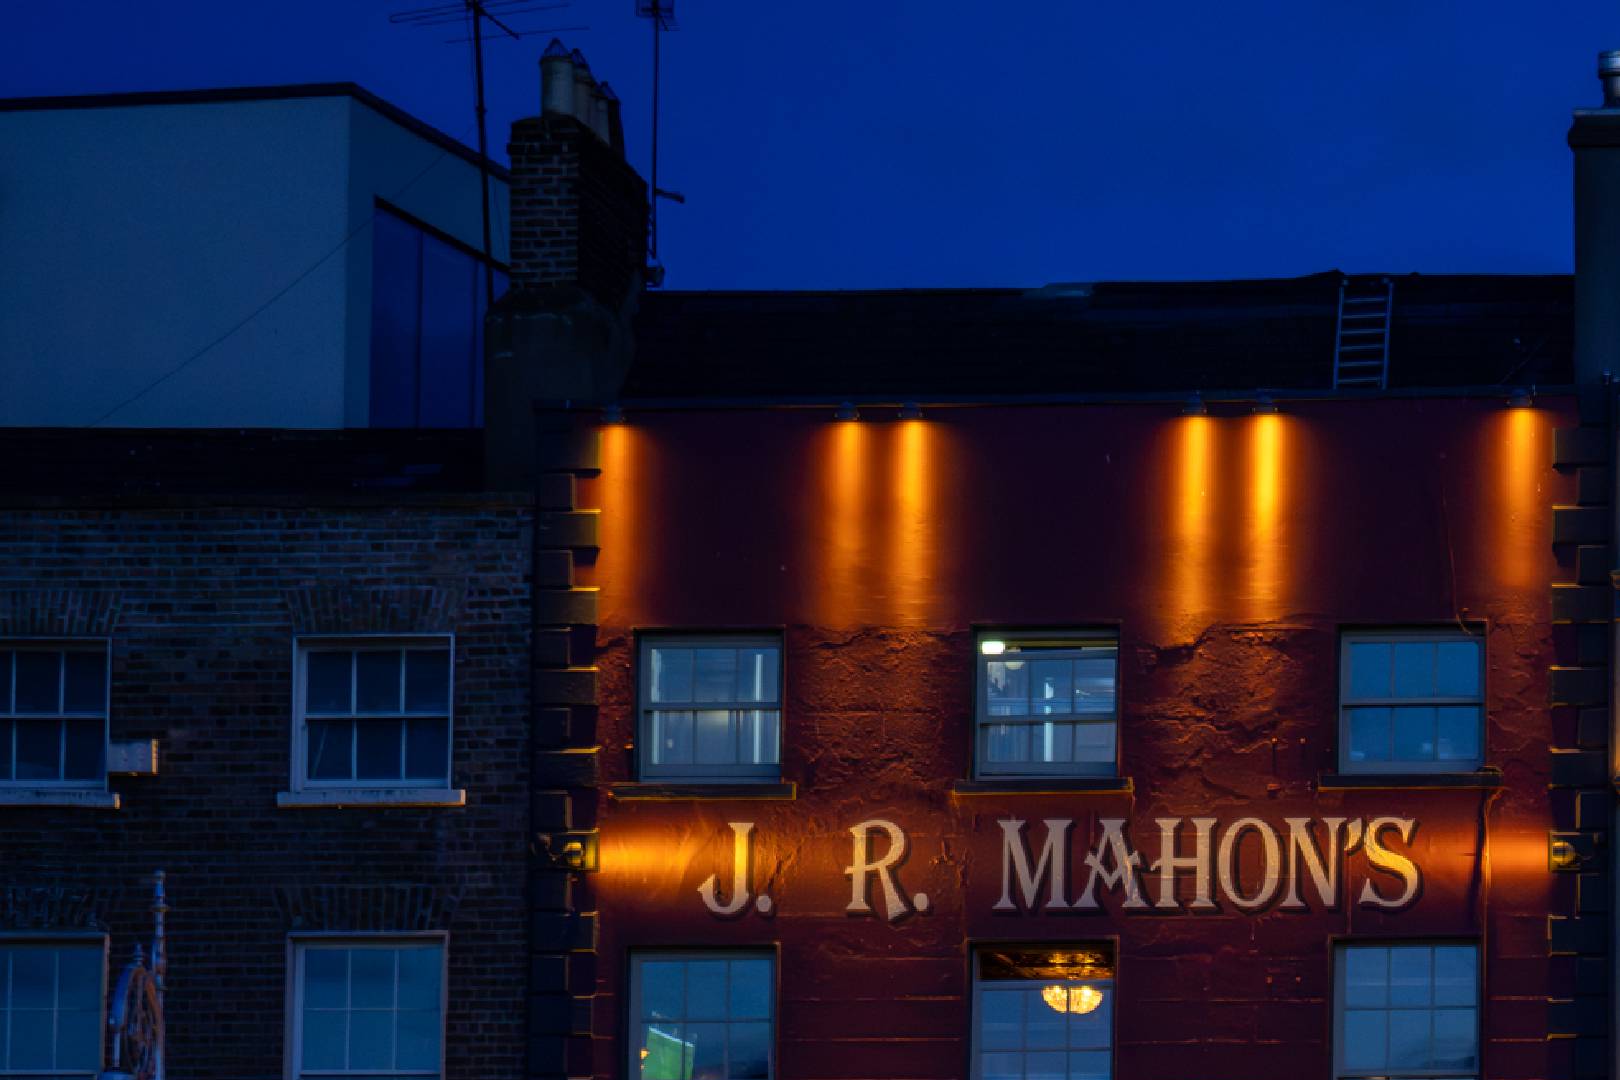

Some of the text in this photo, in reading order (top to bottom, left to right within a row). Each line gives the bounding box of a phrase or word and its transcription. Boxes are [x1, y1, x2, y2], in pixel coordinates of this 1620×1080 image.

[697, 816, 1421, 923] J. R. MAHON'S
